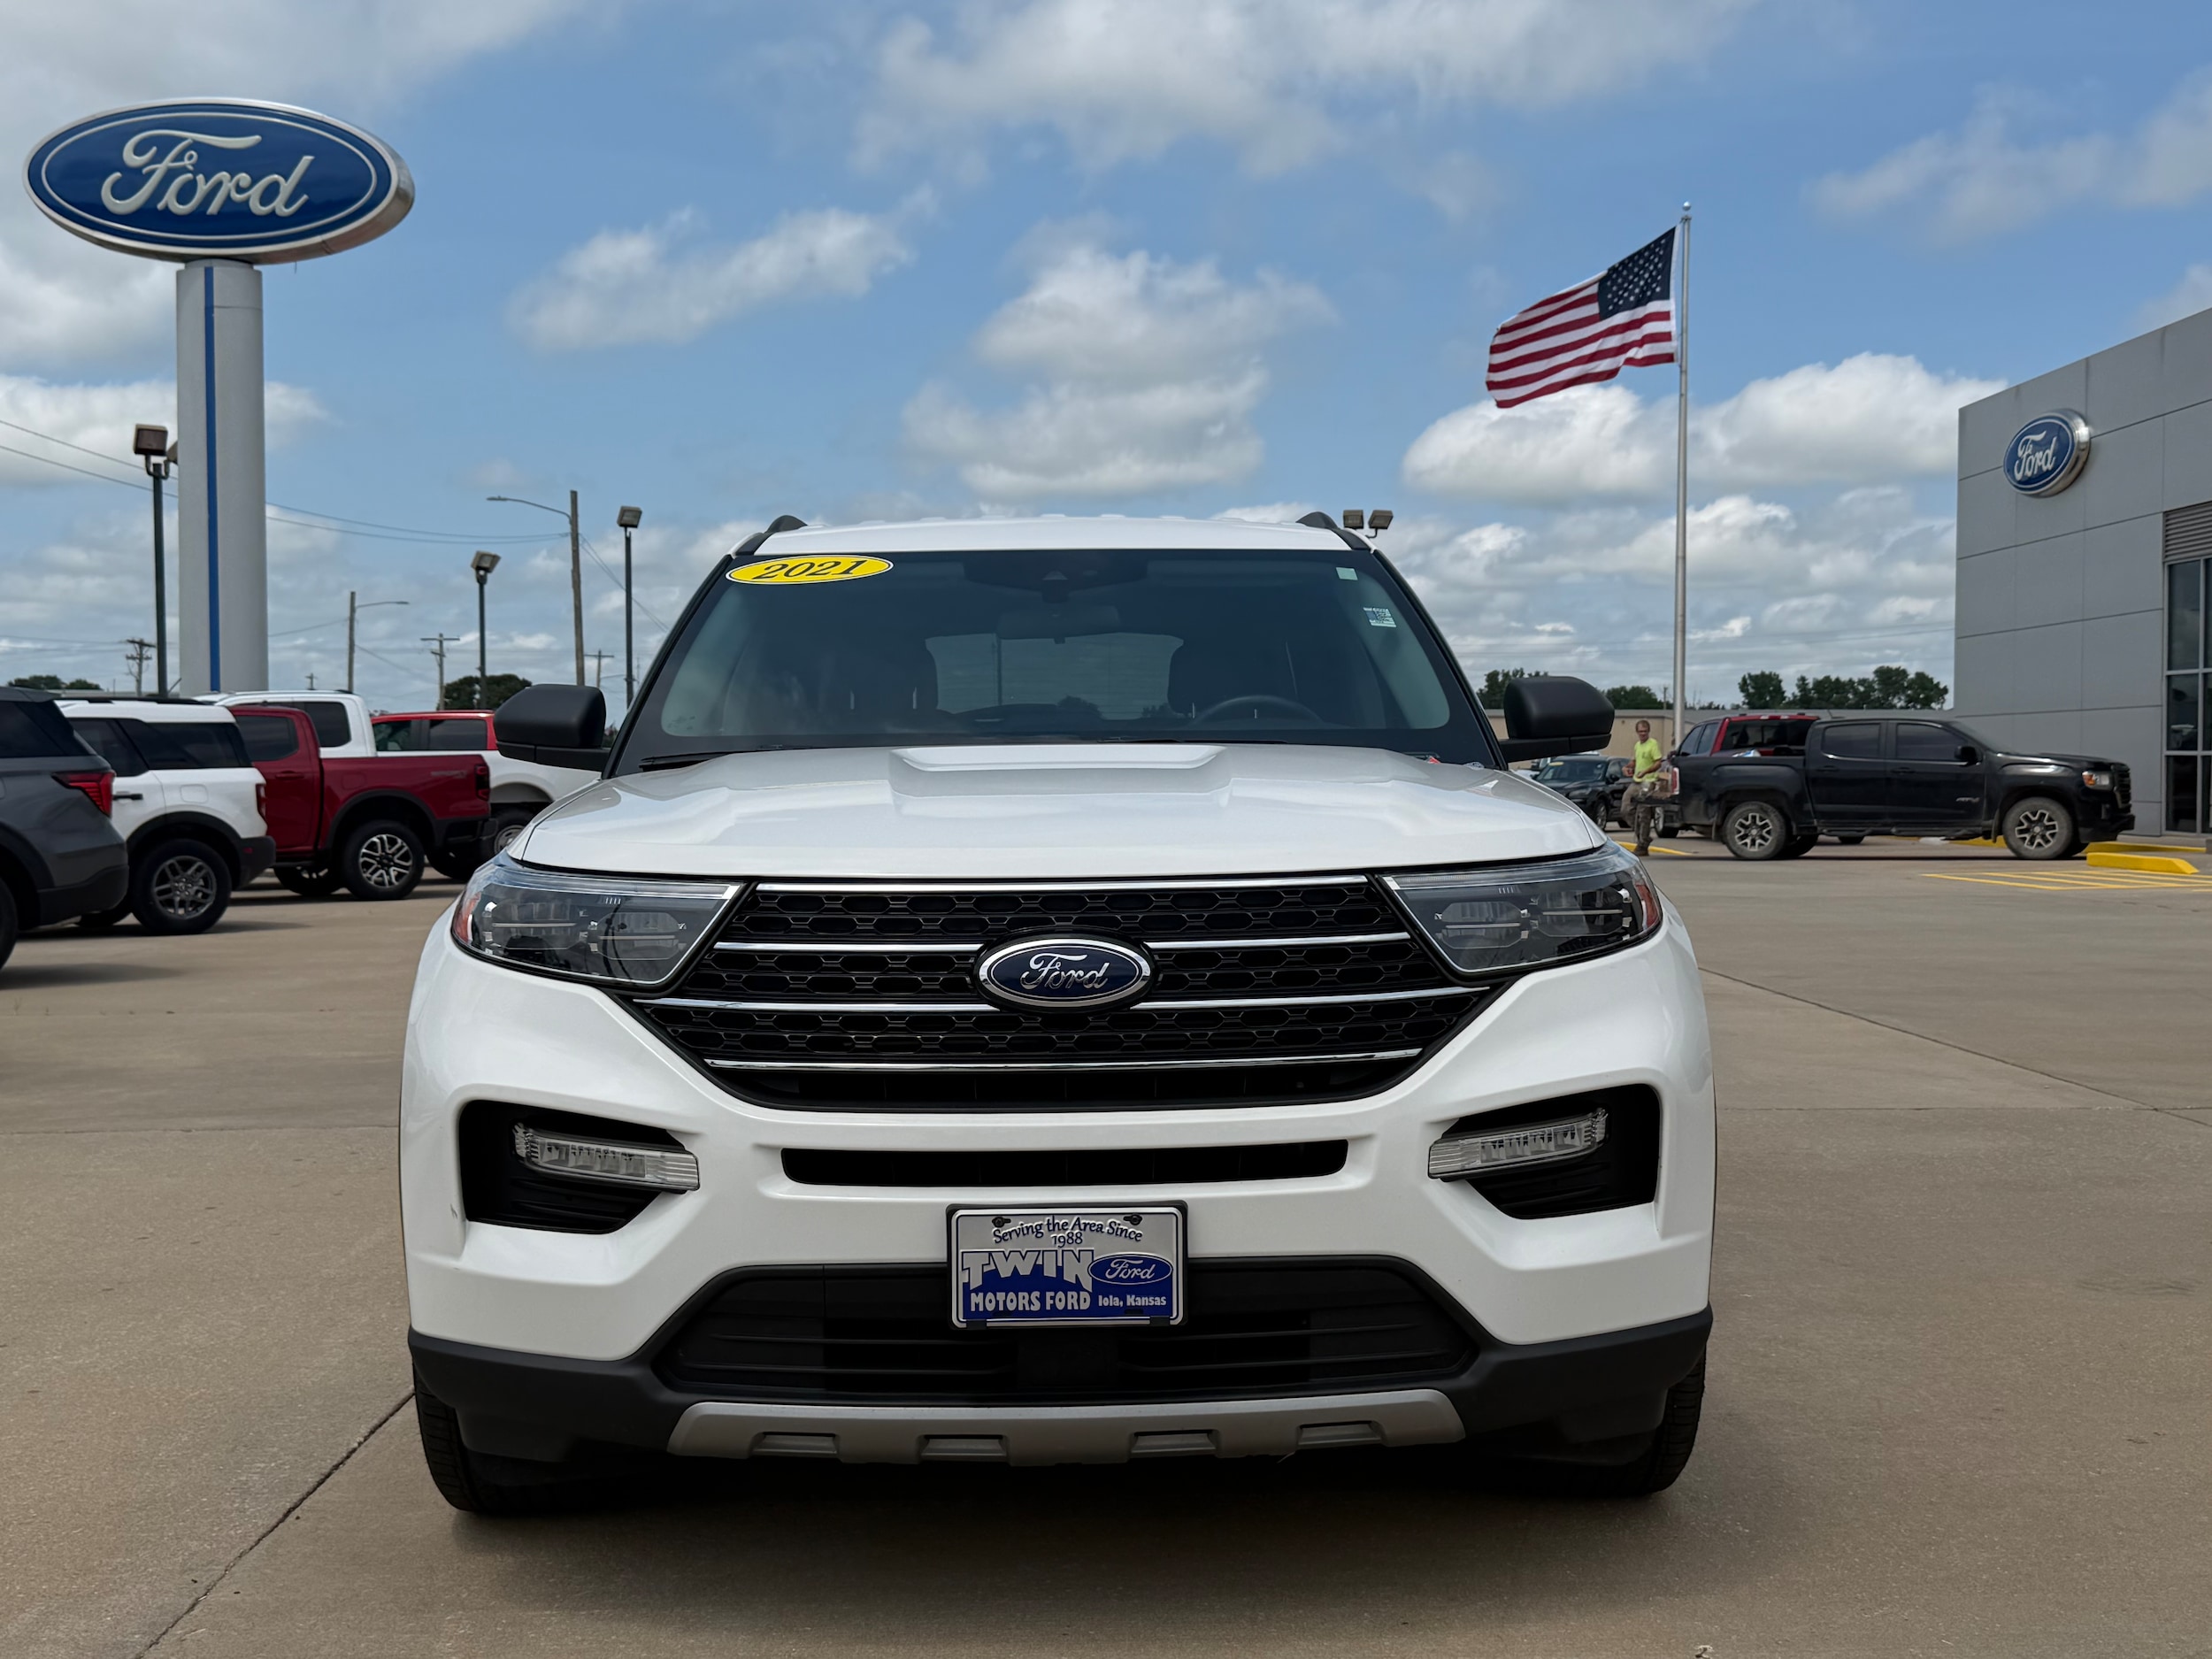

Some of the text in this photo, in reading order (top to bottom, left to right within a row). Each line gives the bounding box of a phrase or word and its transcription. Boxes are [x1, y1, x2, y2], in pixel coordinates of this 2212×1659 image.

[101, 129, 315, 217] Ford
[2014, 430, 2057, 481] Ford
[752, 560, 867, 580] 2021
[1019, 952, 1110, 989] Ford
[993, 1215, 1142, 1244] Serving the Area Since
[1051, 1232, 1083, 1248] 1988
[961, 1249, 1094, 1293] TWIN
[1105, 1258, 1155, 1279] Ford
[971, 1291, 1091, 1312] MOTORS FORD
[1098, 1294, 1166, 1308] Iola, Kansas
